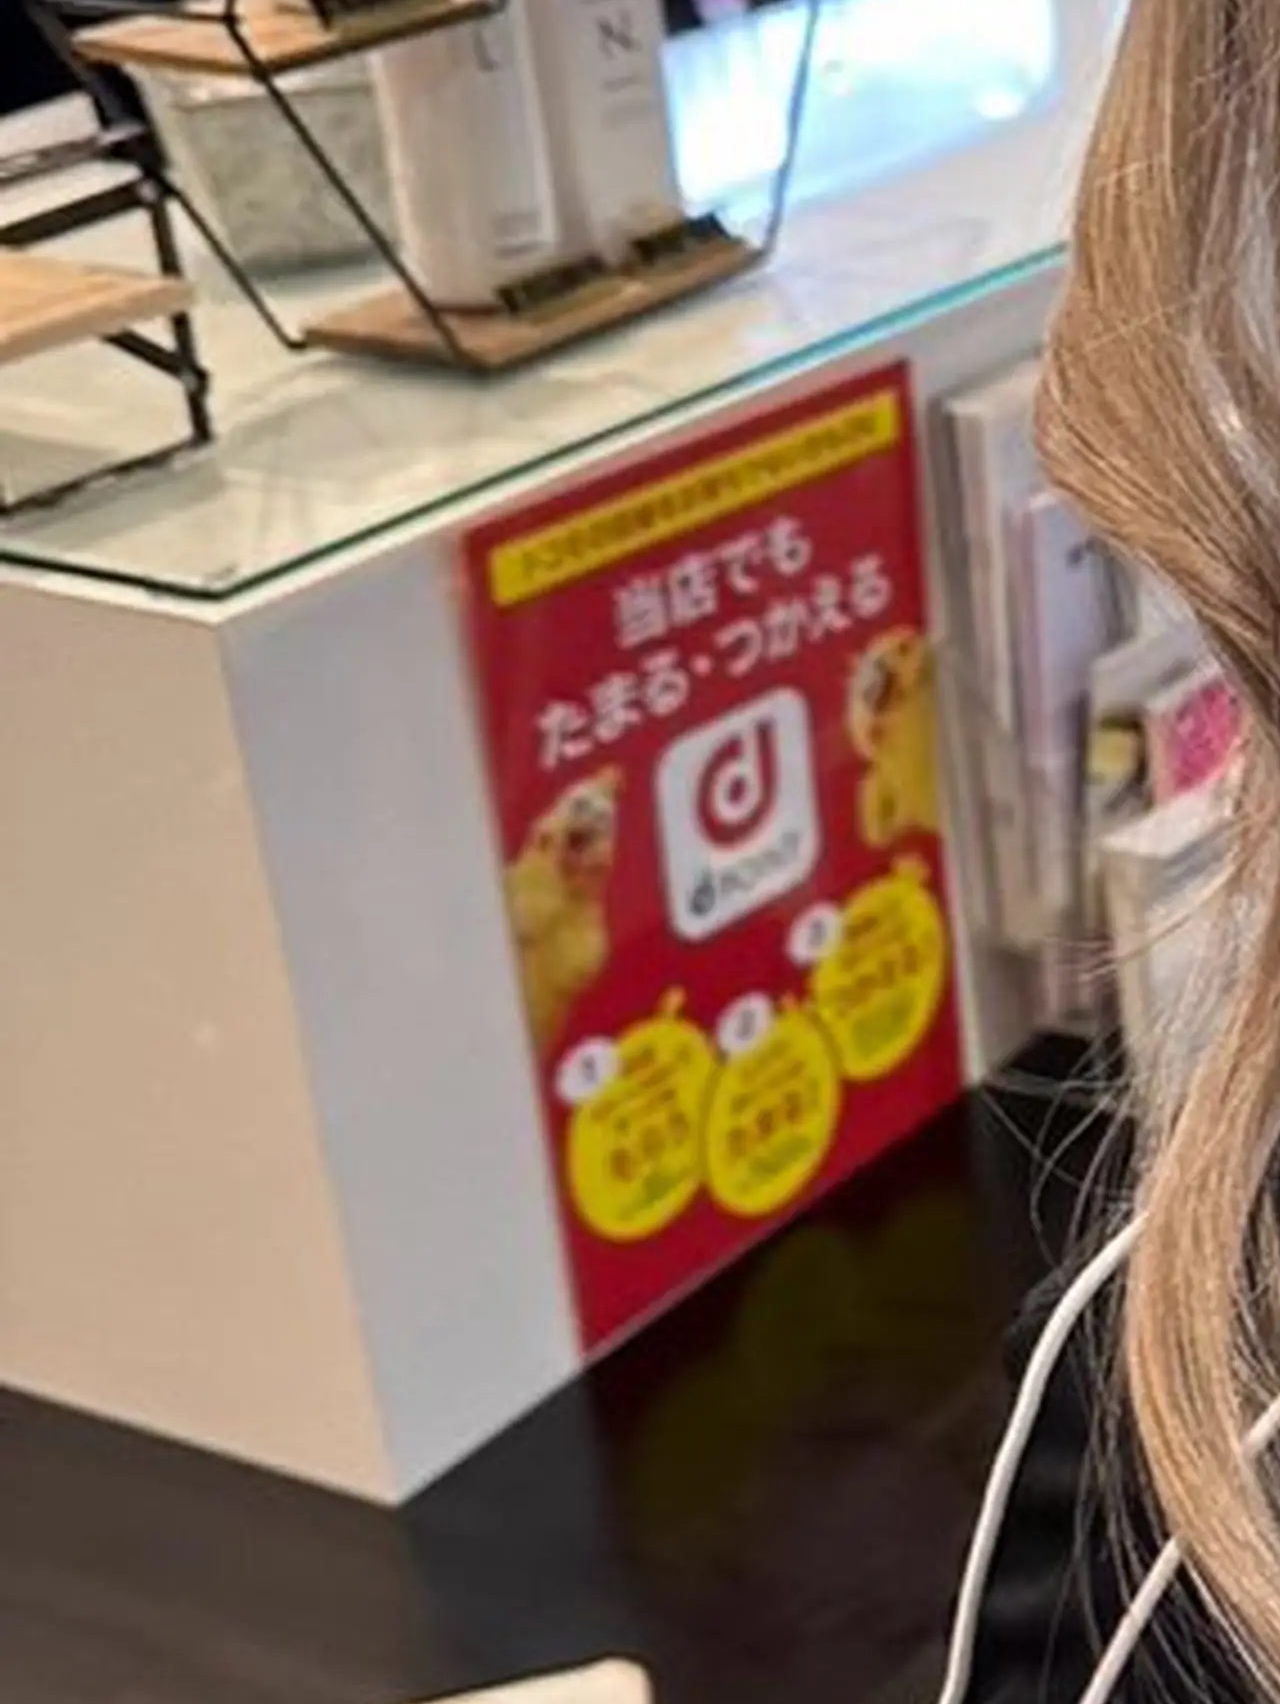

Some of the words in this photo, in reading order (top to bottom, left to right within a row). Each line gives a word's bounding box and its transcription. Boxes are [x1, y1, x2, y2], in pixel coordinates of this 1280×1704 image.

[534, 552, 894, 772] たまる・つかえる
[613, 514, 812, 651] 当店でも
